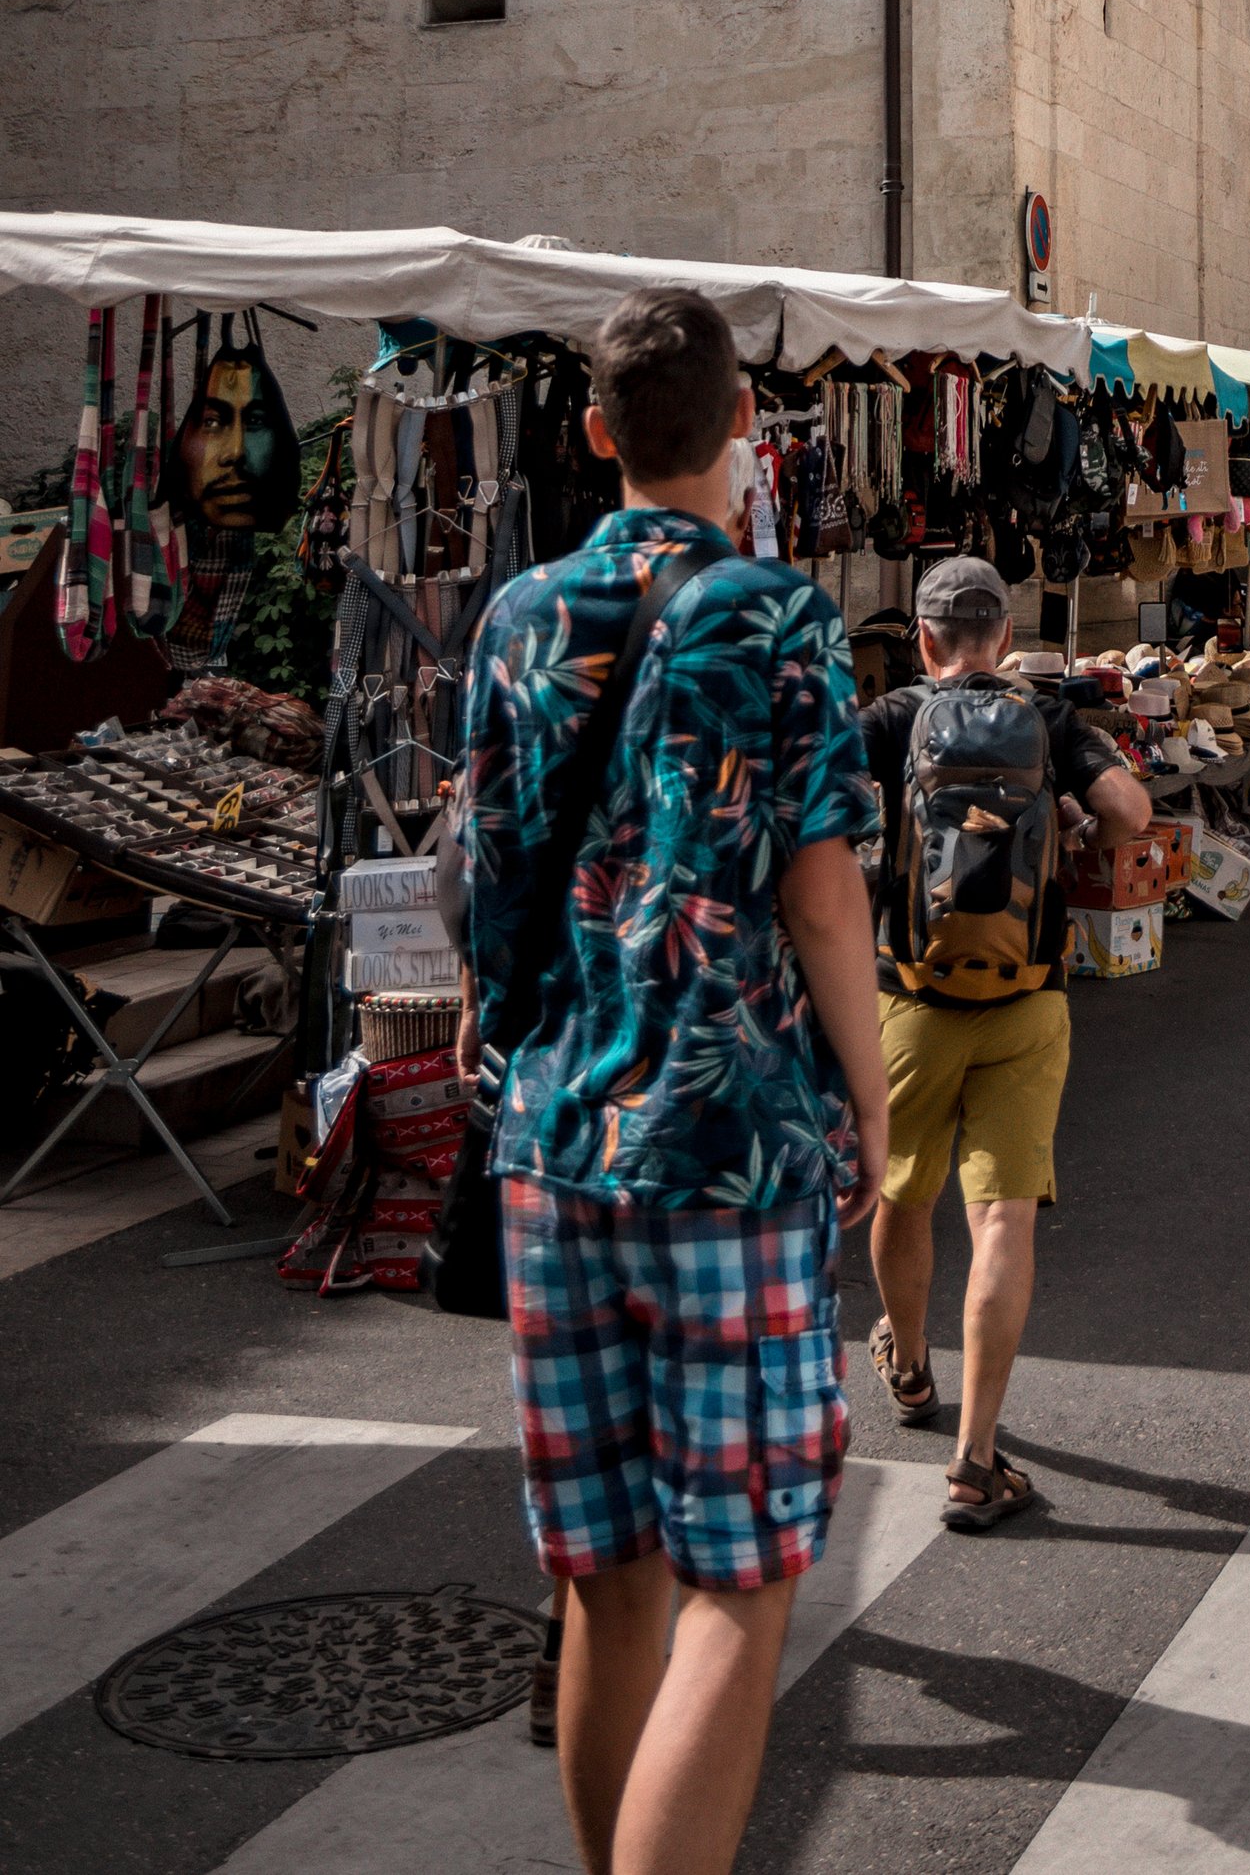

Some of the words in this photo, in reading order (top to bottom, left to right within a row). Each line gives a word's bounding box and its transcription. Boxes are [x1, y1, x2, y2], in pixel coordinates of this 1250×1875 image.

[343, 873, 394, 908] LOOKS
[400, 869, 438, 905] STYL
[396, 923, 422, 935] Mei
